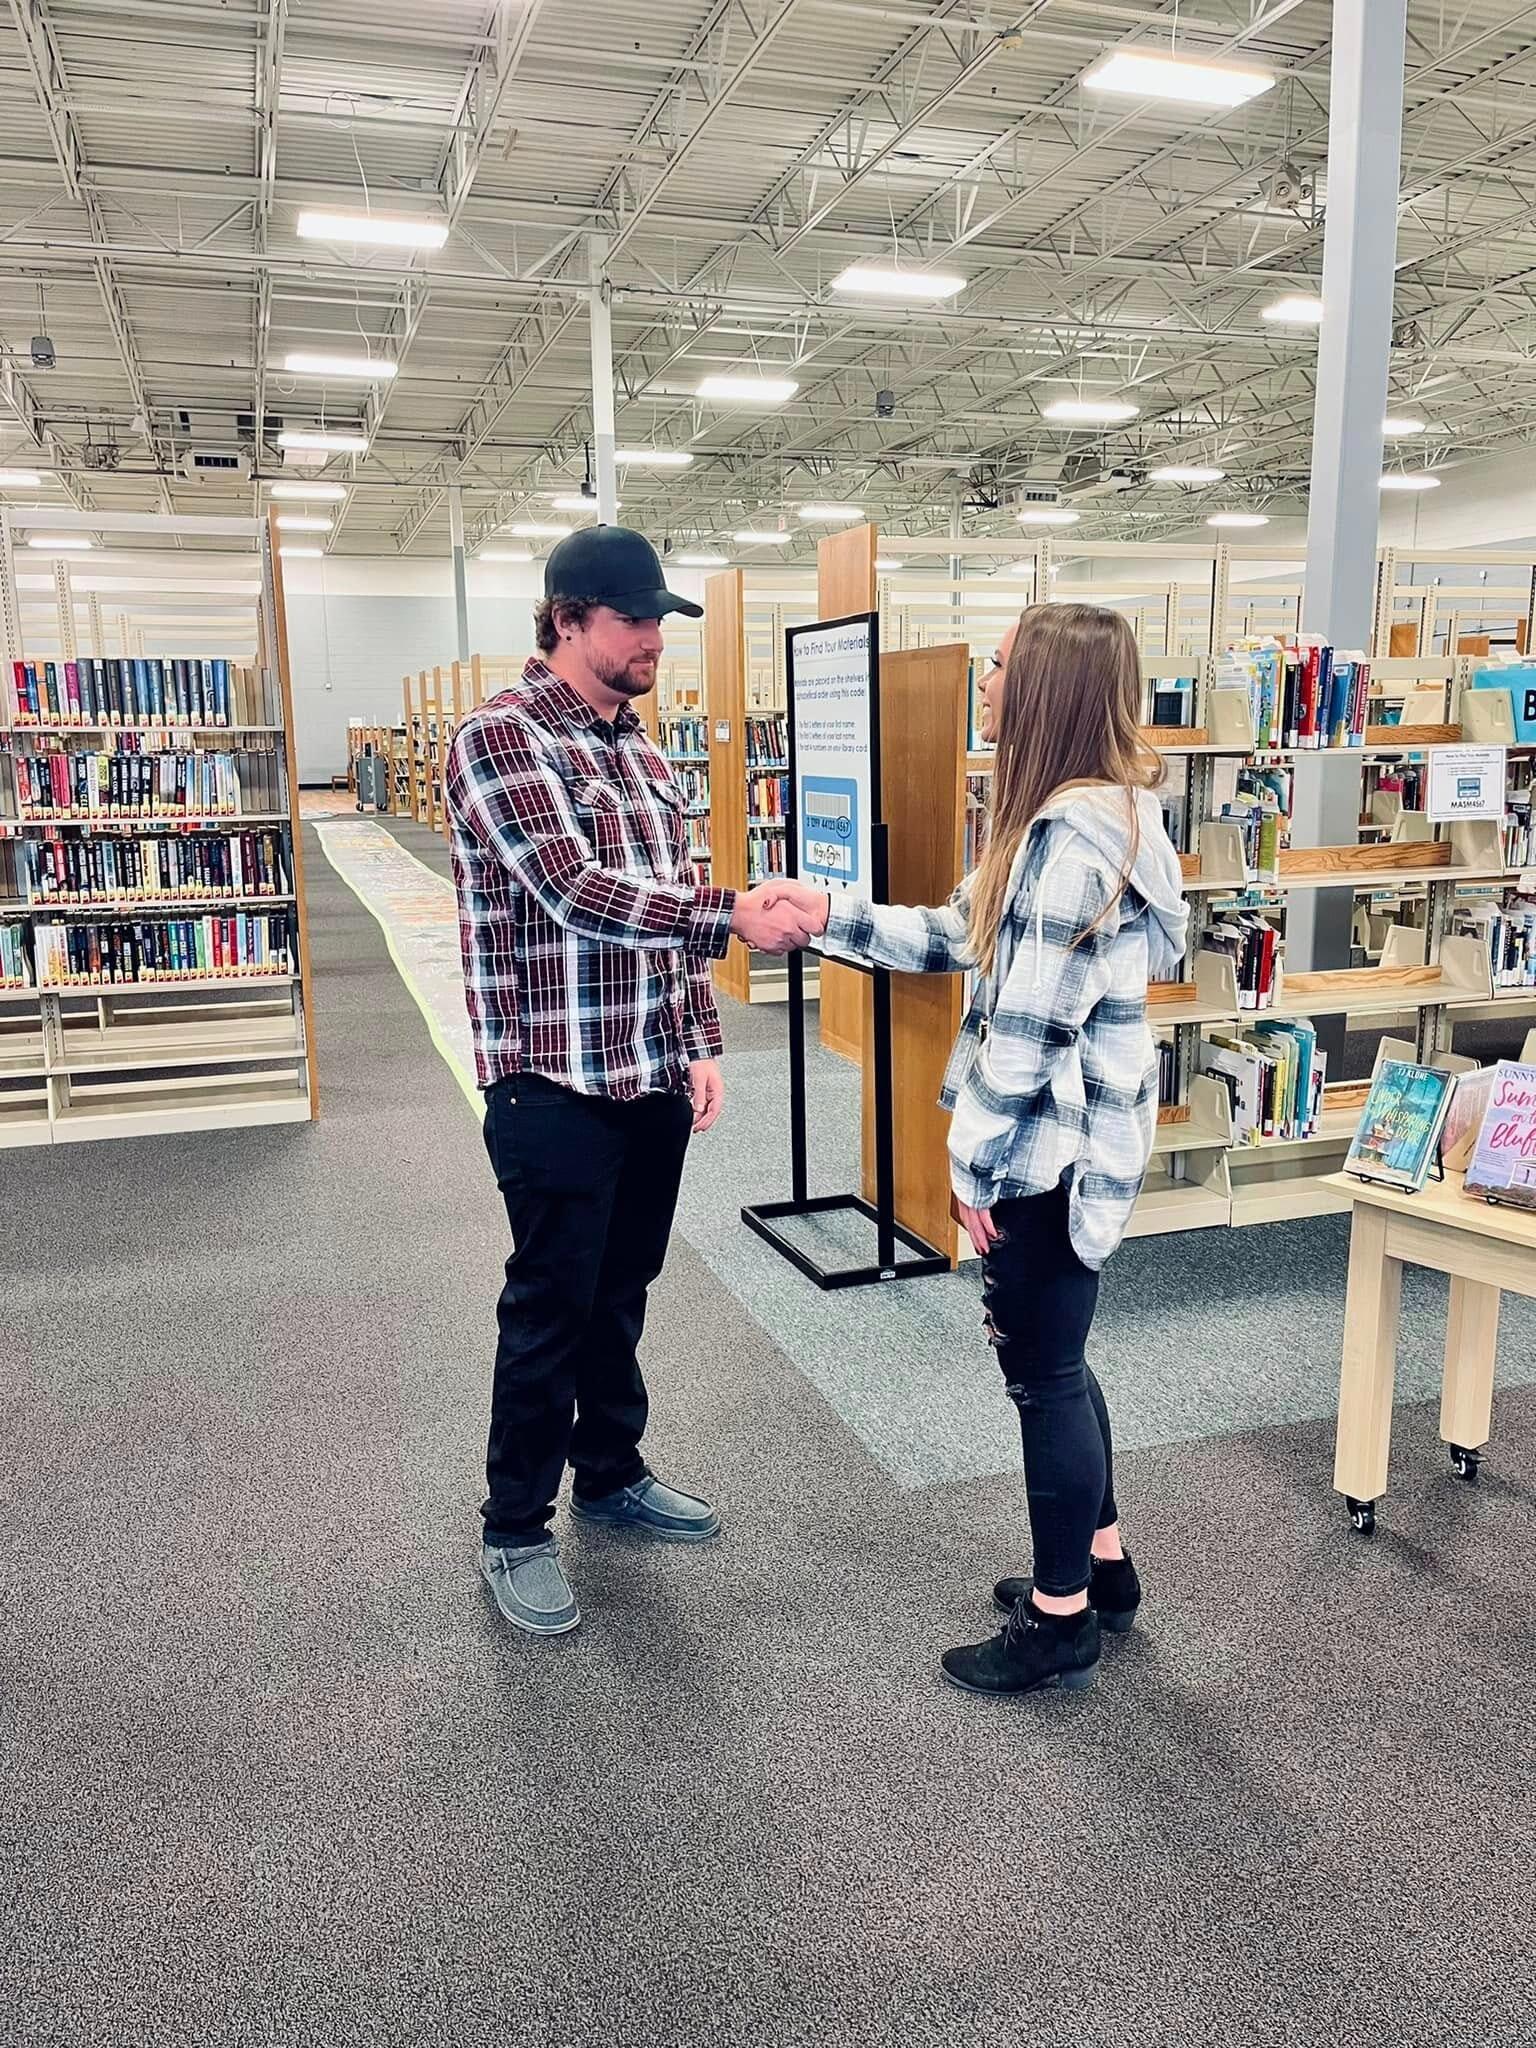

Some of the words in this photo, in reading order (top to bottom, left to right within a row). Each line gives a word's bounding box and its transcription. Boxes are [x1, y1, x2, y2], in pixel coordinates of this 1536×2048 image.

[811, 641, 824, 655] Find
[1406, 1069, 1430, 1081] KLUNE
[1498, 1069, 1536, 1083] SUNNY
